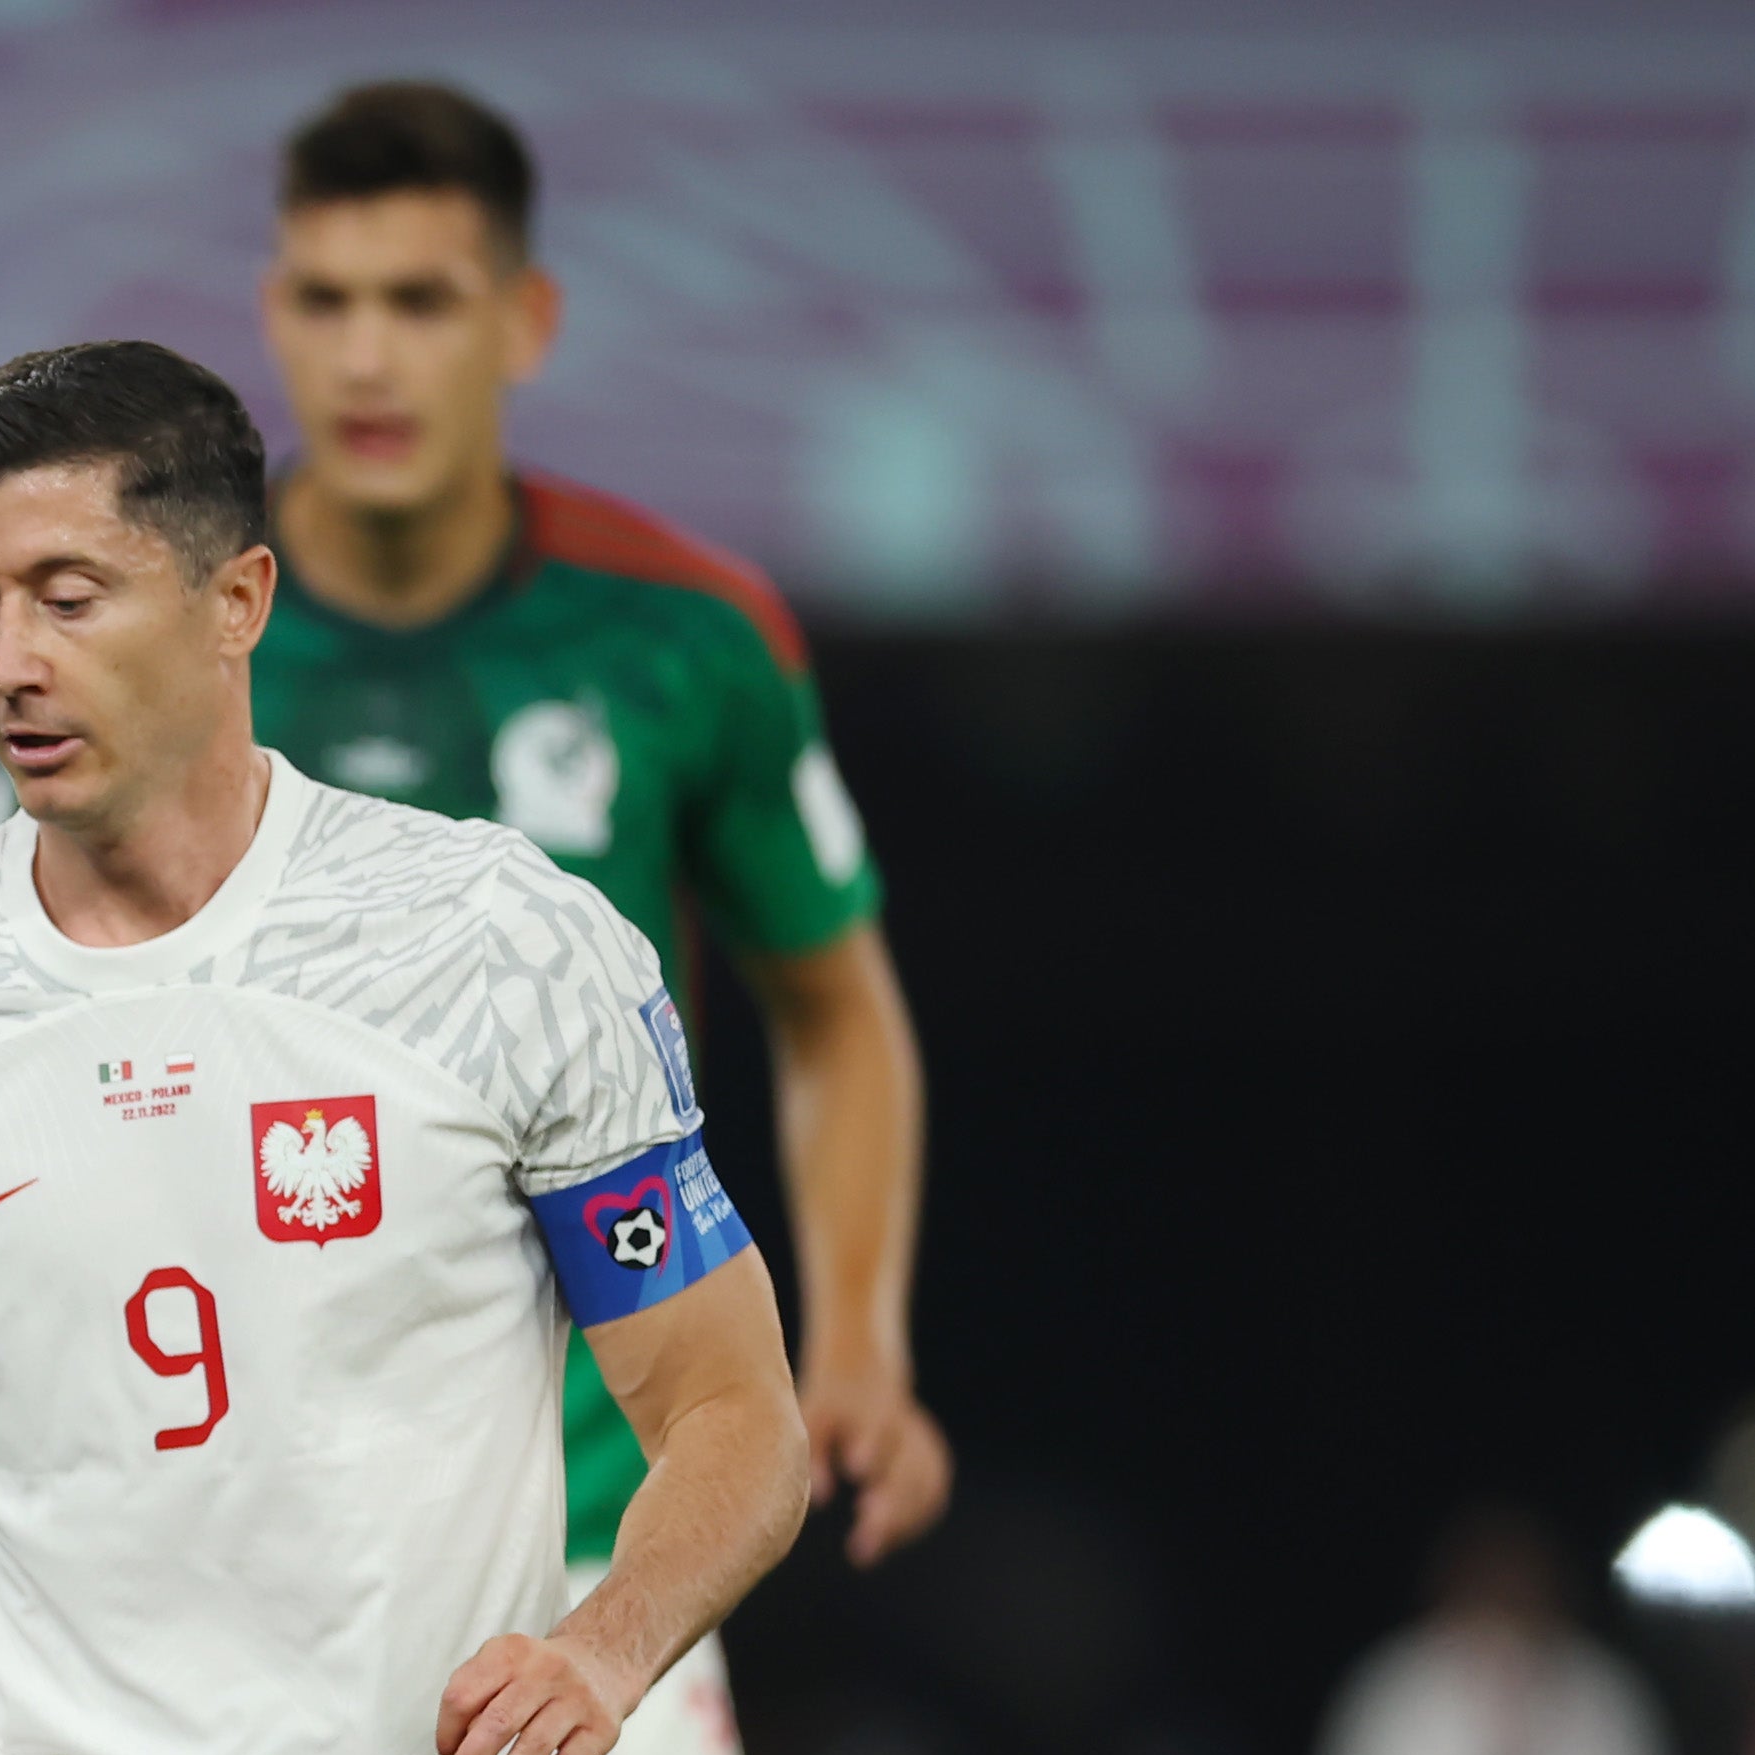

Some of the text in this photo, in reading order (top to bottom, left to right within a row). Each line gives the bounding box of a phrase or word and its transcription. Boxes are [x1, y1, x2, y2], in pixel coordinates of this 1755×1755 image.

[103, 1091, 142, 1105] MEXICO
[151, 1084, 192, 1099] POLAND
[124, 1266, 230, 1451] 9
